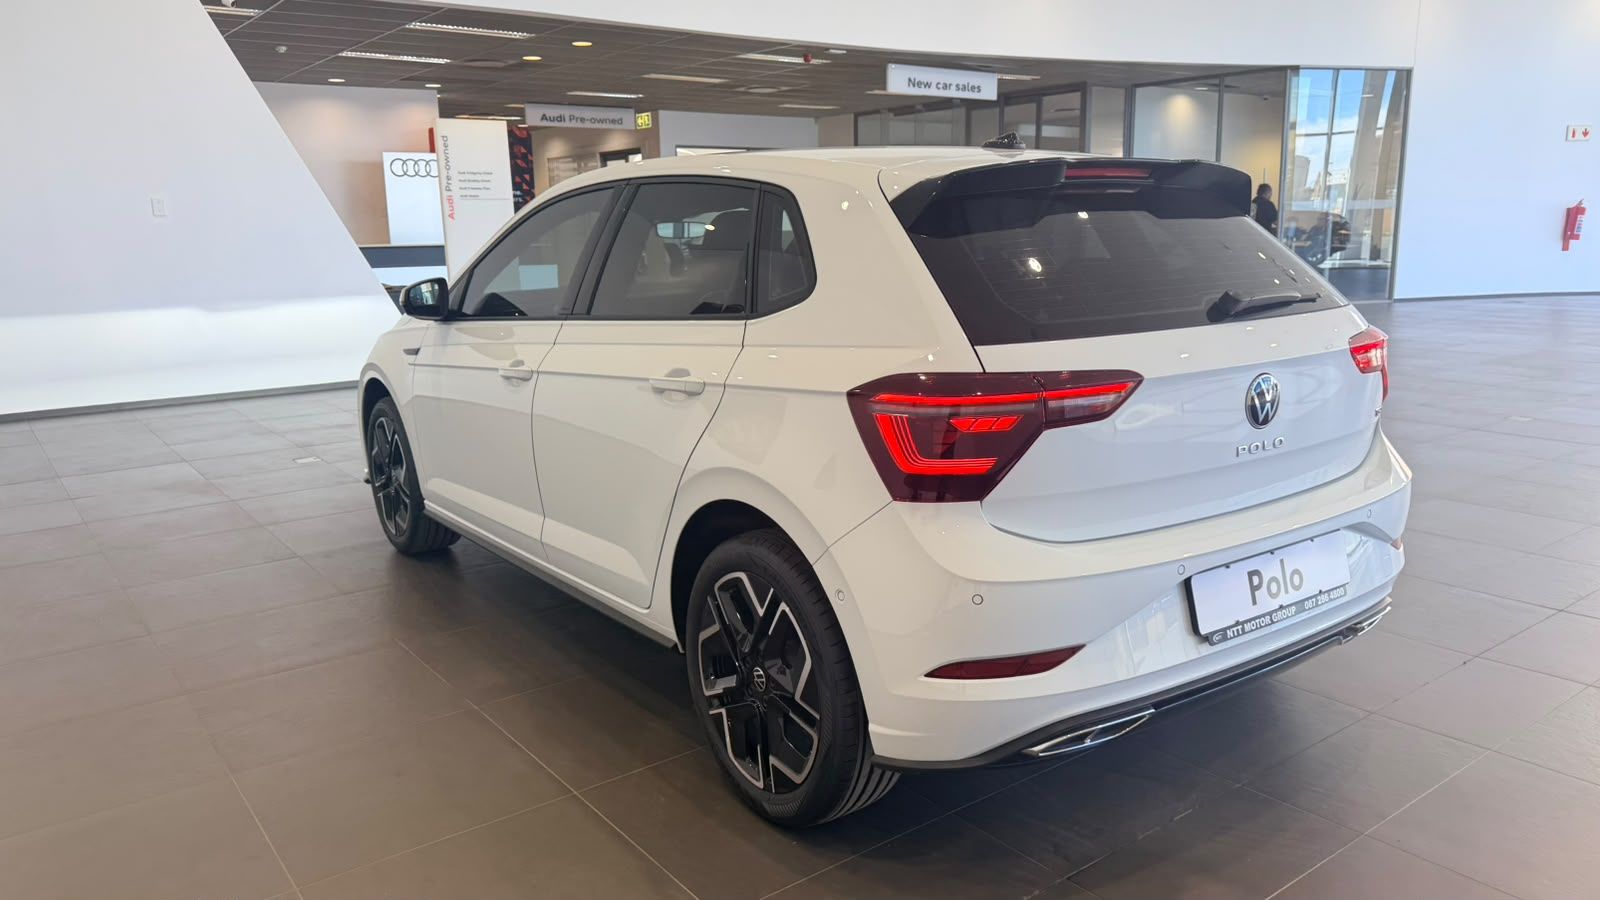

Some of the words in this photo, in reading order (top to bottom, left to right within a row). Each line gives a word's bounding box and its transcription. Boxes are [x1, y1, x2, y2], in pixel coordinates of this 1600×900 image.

[907, 77, 933, 89] New
[935, 80, 953, 91] car
[955, 82, 982, 93] sales
[540, 113, 566, 123] Audi
[568, 114, 624, 125] Pre-owned
[441, 135, 453, 192] Pre-owned
[447, 194, 456, 221] Audi
[1235, 436, 1285, 458] POLO
[1246, 558, 1304, 606] Polo
[1226, 625, 1243, 639] NTT
[1244, 615, 1271, 632] MOTOR
[1272, 606, 1296, 622] GROUP
